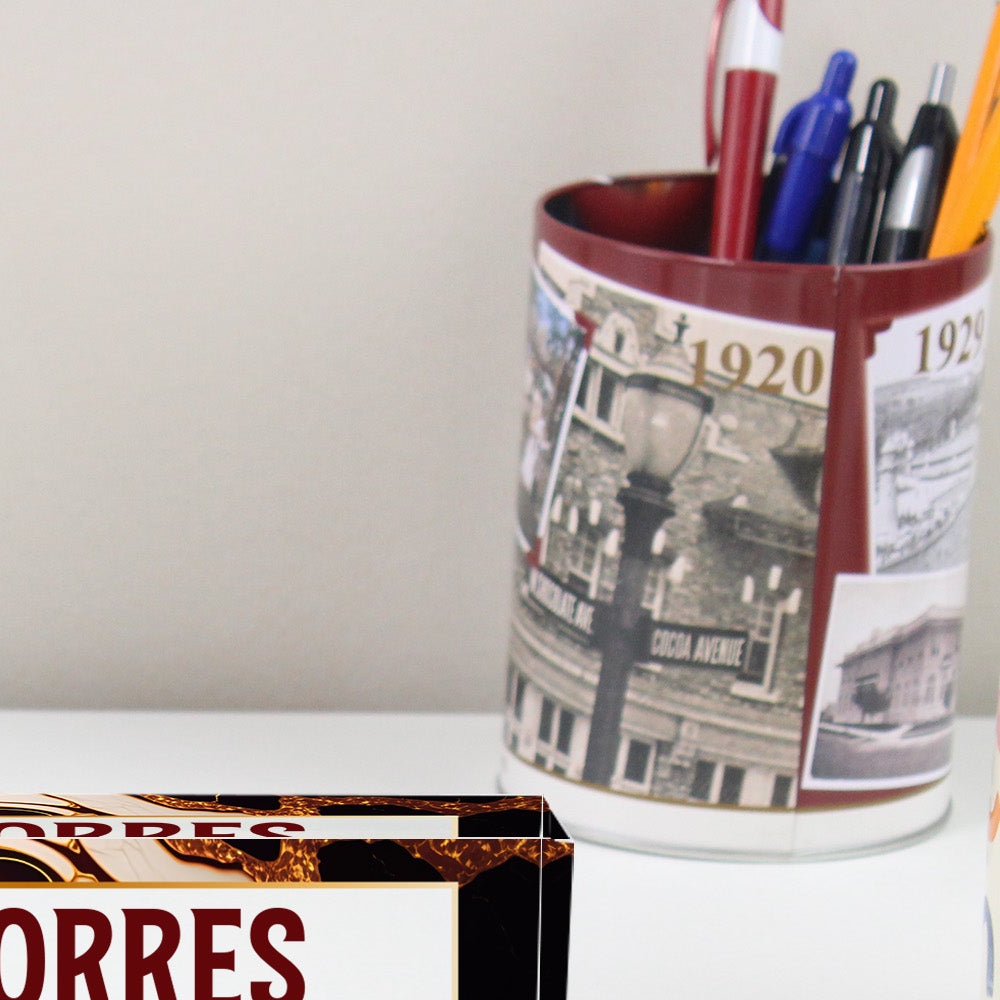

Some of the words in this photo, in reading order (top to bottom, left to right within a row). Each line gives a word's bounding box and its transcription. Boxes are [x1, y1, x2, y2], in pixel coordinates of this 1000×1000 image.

[689, 339, 825, 397] 1920
[651, 628, 693, 661] COCOA
[693, 634, 746, 667] AVENUE
